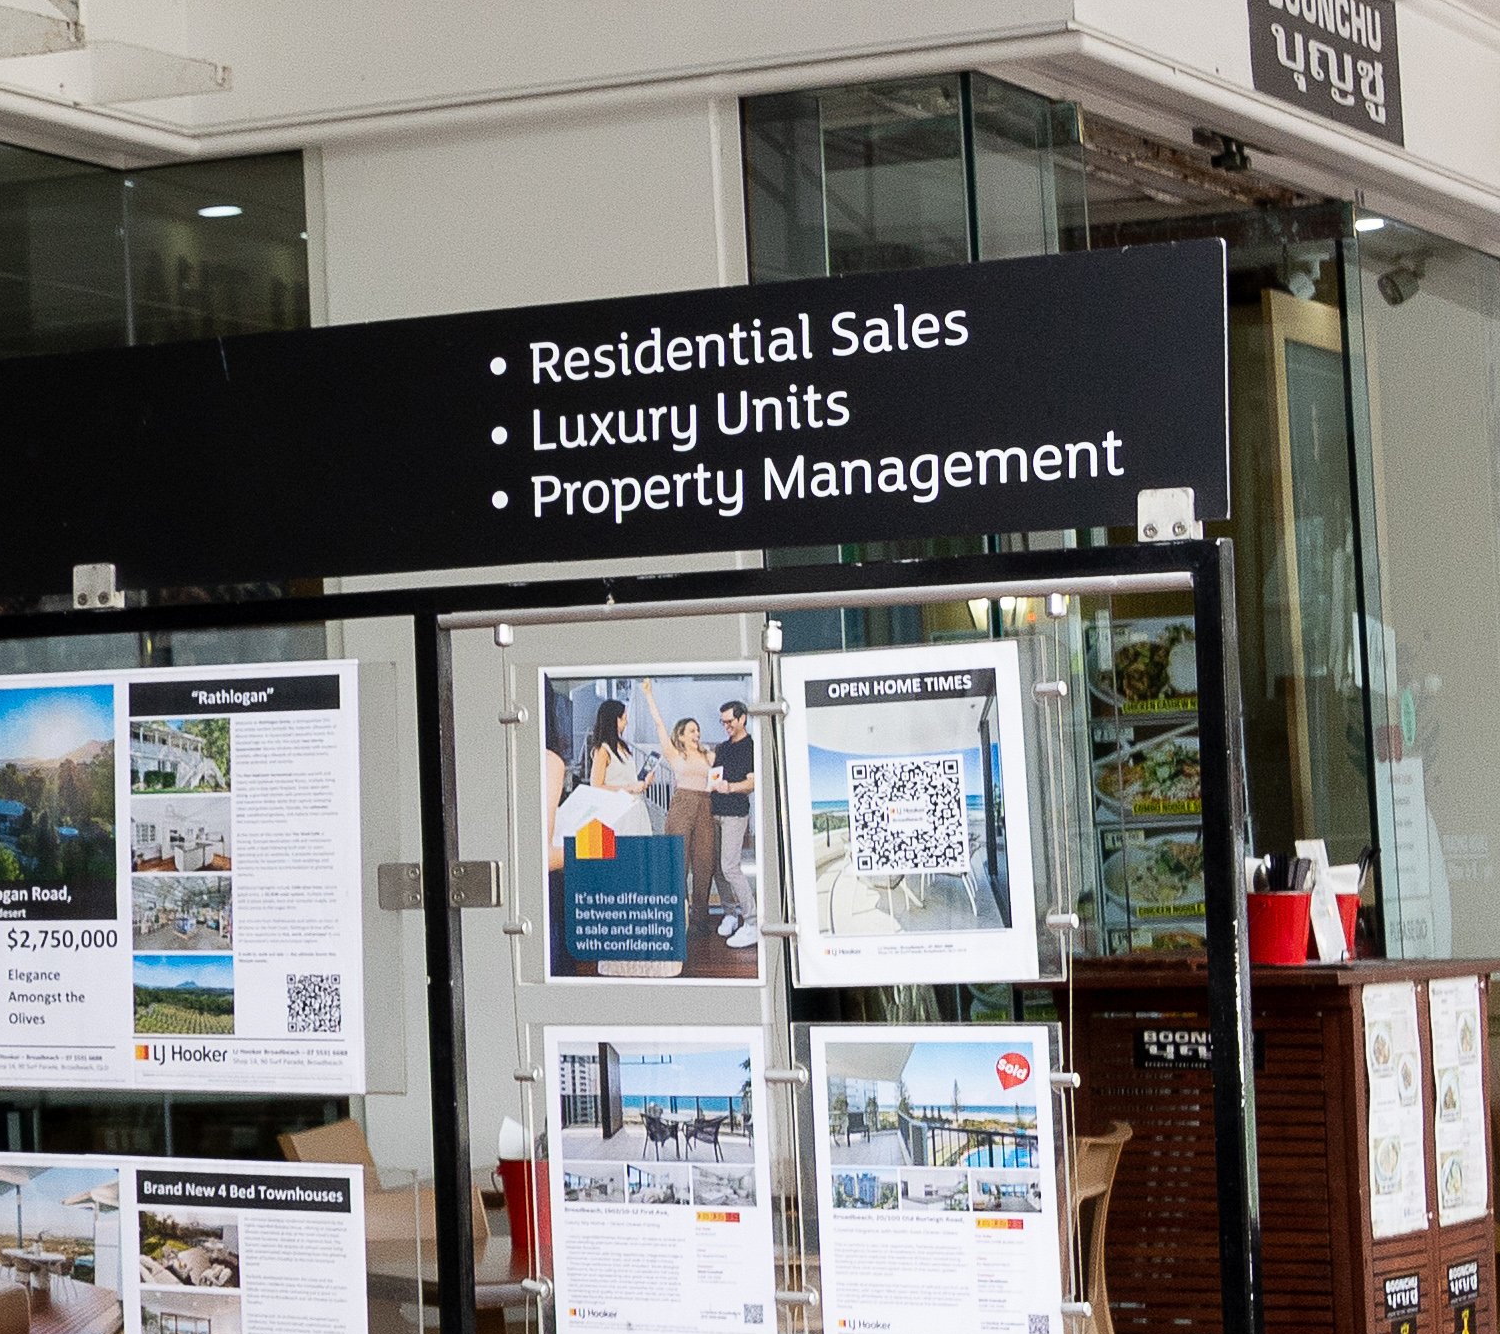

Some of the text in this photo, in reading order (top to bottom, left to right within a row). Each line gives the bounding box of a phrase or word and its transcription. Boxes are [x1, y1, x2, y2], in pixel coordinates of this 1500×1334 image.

[530, 303, 970, 384] Residential Sales
[532, 385, 850, 452] Luxury Units
[532, 430, 1124, 524] Property Management
[828, 675, 972, 698] OPEN HOME TIMES
[32, 886, 72, 904] Road,
[596, 893, 614, 904] the
[617, 892, 678, 904] difference
[576, 908, 673, 922] between making
[576, 923, 673, 937] a sale and selling
[7, 928, 118, 951] $2,750,000
[576, 939, 674, 951] with confidence.
[8, 969, 60, 983] Elegance
[9, 991, 85, 1005] Amongst the
[9, 1014, 45, 1024] Olives
[1144, 1031, 1211, 1043] BOON
[154, 1046, 227, 1065] LJ Hooker
[997, 1055, 1027, 1081] Sold
[144, 1181, 343, 1203] Brand New 4 Bed Townhouses
